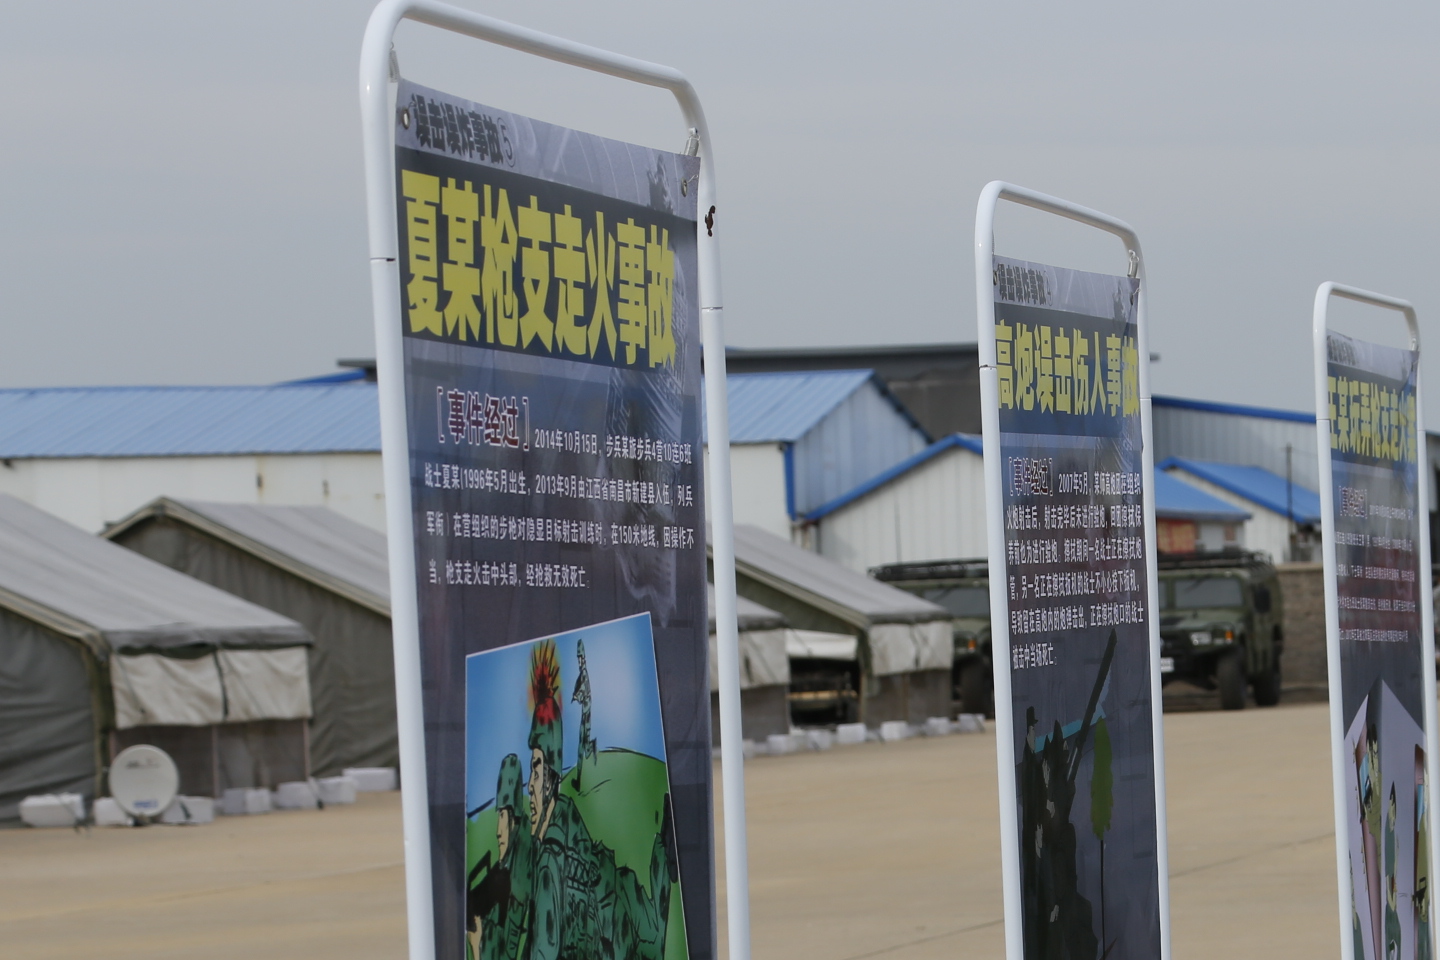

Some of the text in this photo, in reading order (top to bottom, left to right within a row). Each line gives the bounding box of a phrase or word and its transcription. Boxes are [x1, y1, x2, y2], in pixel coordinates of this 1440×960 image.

[402, 169, 676, 371] 夏某枪支走火事故
[995, 319, 1139, 417] 高炮误击伤人事故
